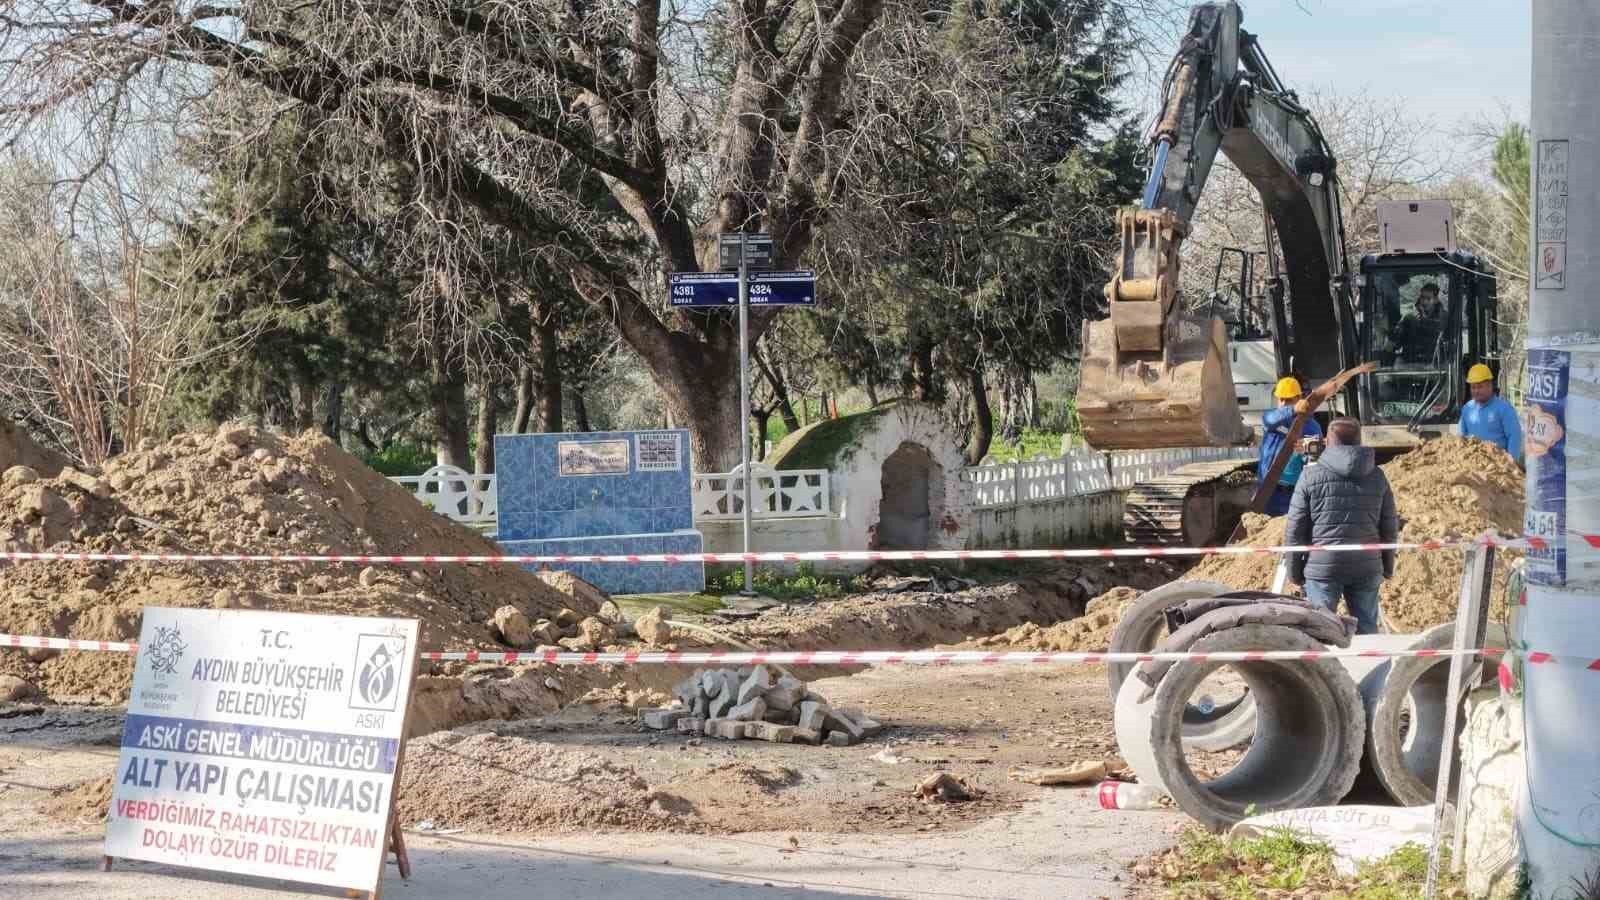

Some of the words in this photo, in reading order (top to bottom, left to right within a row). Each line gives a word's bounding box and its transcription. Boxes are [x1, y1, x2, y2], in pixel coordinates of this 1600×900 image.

[750, 284, 771, 295] 4324
[260, 630, 293, 649] T.C.
[192, 658, 241, 683] AYDIN
[242, 656, 344, 696] BÜYÜKŞEHİR
[216, 691, 308, 721] BELEDİYESİ
[139, 722, 183, 750] ASKİ
[185, 729, 244, 756] GENEL
[250, 729, 379, 769] MÜDÜRLÜĞÜ
[122, 756, 168, 788] ALT
[174, 760, 226, 795] YAPI
[236, 768, 382, 814] ÇALIŞMASI
[117, 798, 214, 826] VERDİĞİMİZ
[220, 815, 377, 849] RAHATSIZLIKTAN
[143, 828, 204, 853] DOLAYI
[210, 827, 258, 862] ÖZÜR
[264, 841, 337, 872] DİLERİZ
